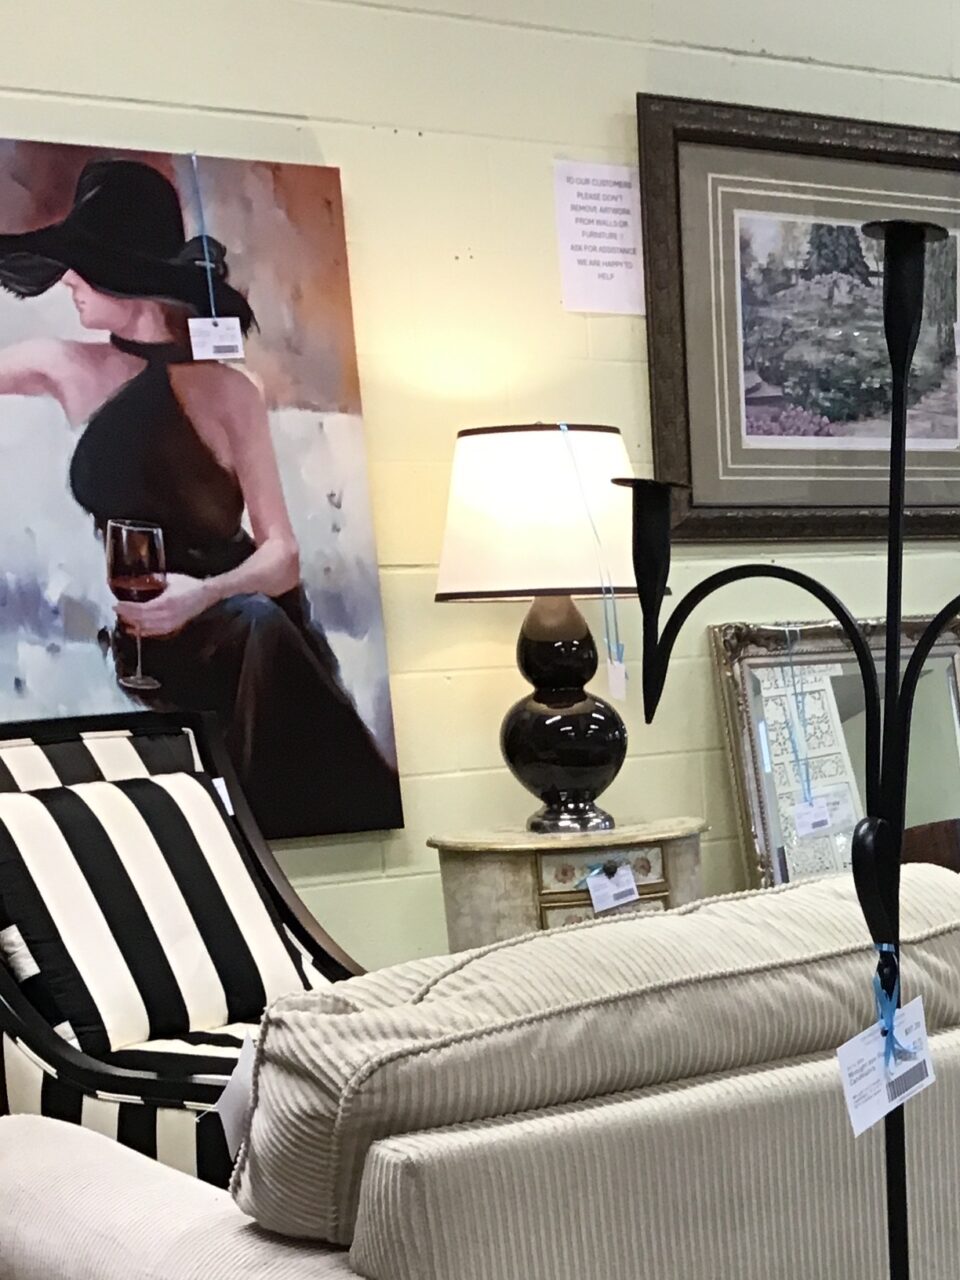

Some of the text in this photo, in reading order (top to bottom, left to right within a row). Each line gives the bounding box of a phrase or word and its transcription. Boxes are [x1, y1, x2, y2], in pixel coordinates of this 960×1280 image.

[566, 176, 574, 184] TO
[592, 178, 632, 189] CUSTOMERS
[577, 192, 623, 201] PLEASE DON'T
[570, 204, 631, 215] REMOVE ARTWORK
[575, 217, 594, 225] FROM
[582, 231, 617, 240] FURNITURE
[624, 261, 633, 269] TO
